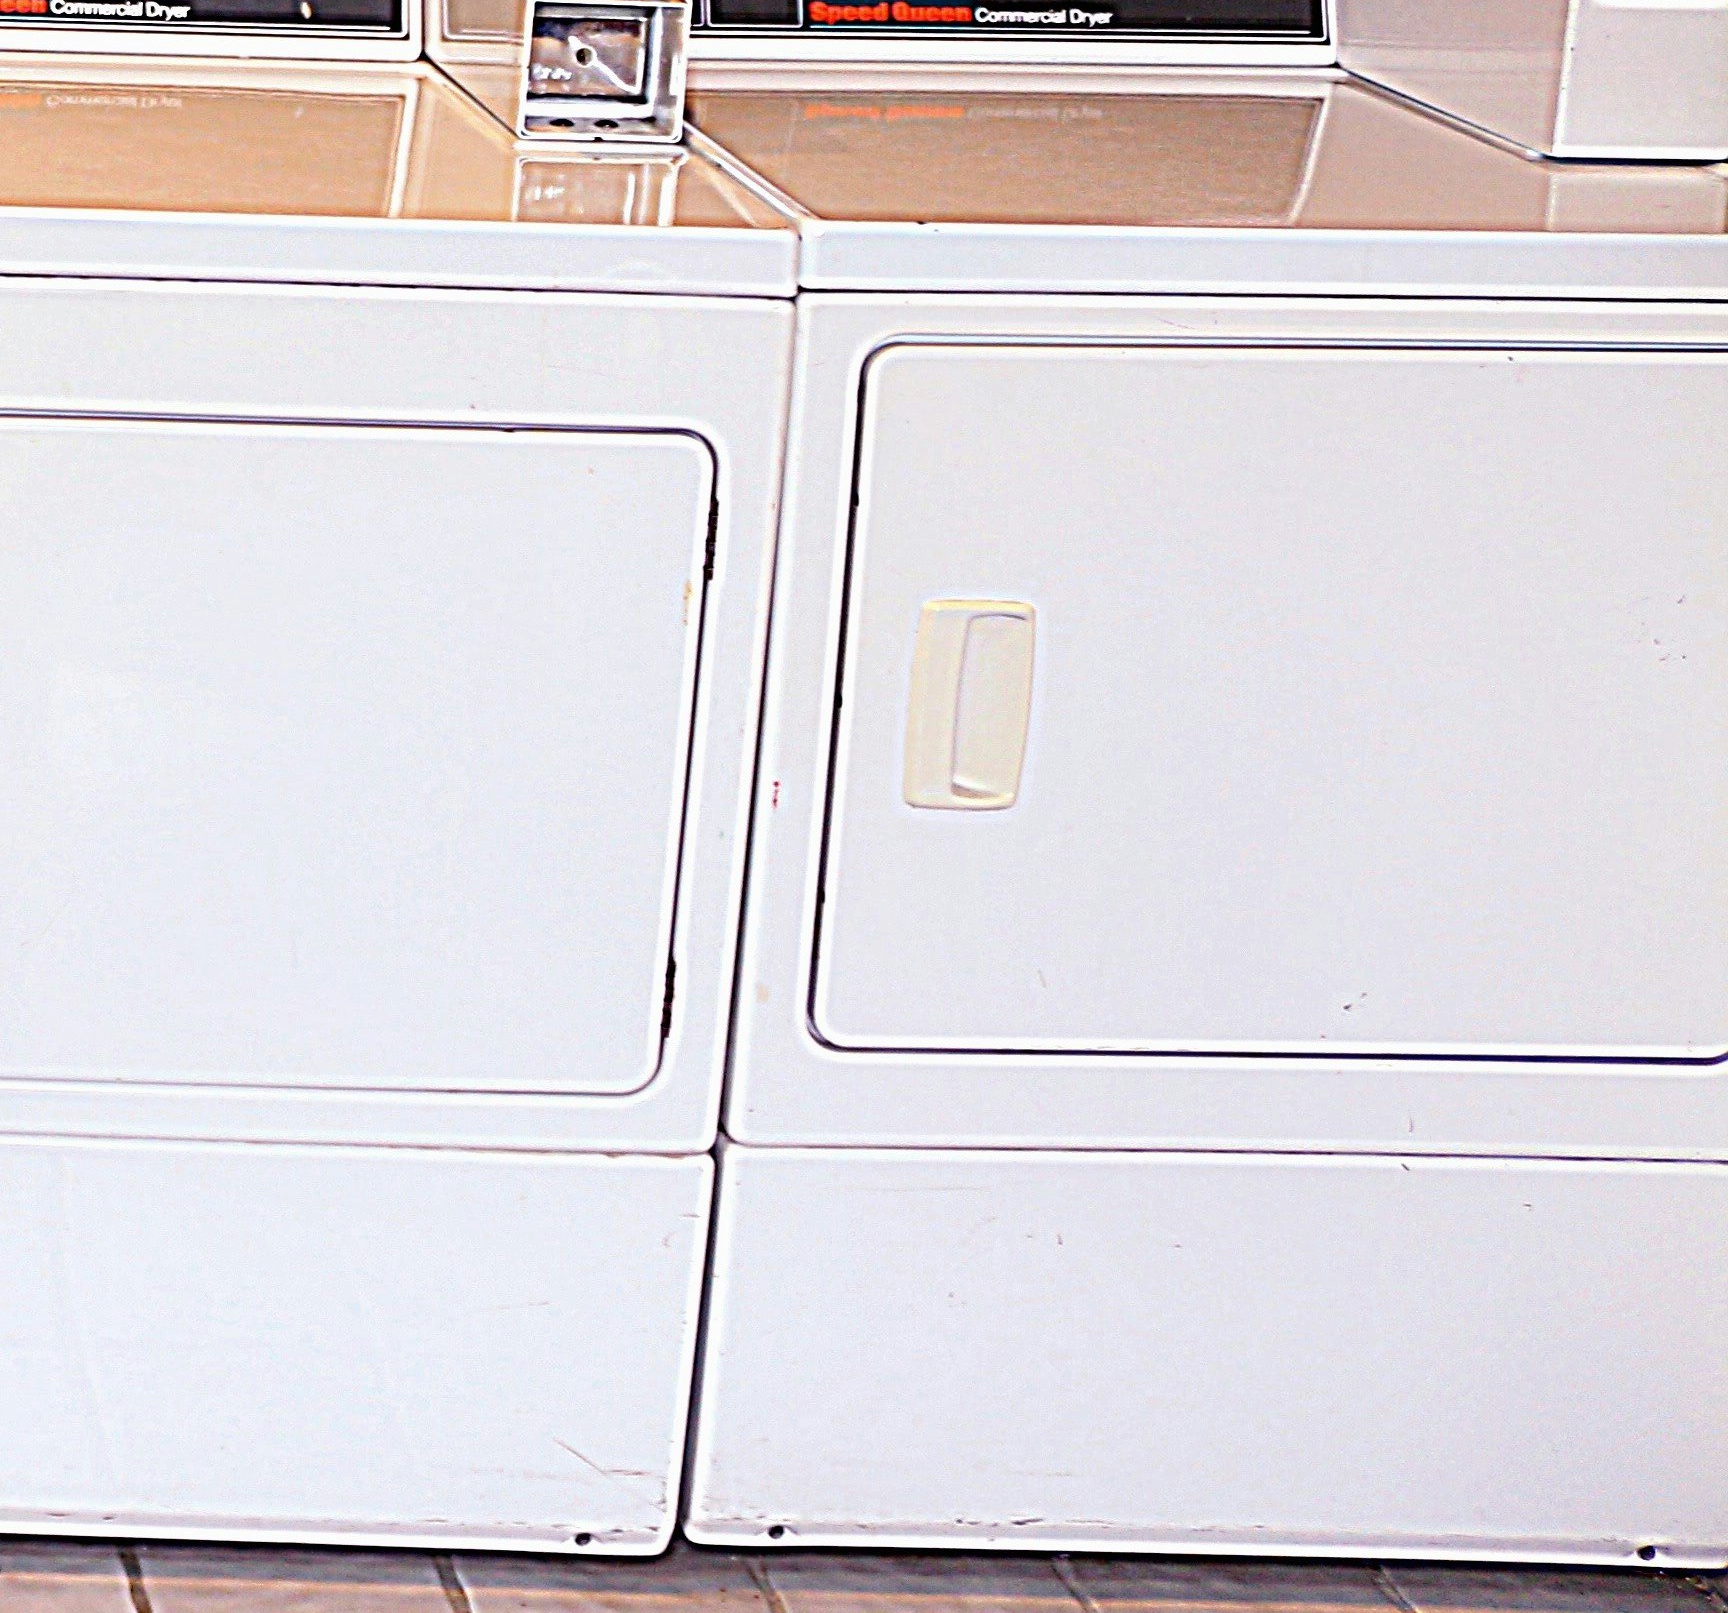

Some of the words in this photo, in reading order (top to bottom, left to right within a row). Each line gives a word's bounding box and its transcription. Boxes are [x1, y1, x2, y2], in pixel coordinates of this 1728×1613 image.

[145, 0, 191, 22] Dryer
[808, 0, 889, 26] Speed
[891, 0, 973, 23] Queen
[974, 6, 1067, 24] Commercial
[1069, 8, 1114, 27] Dryer
